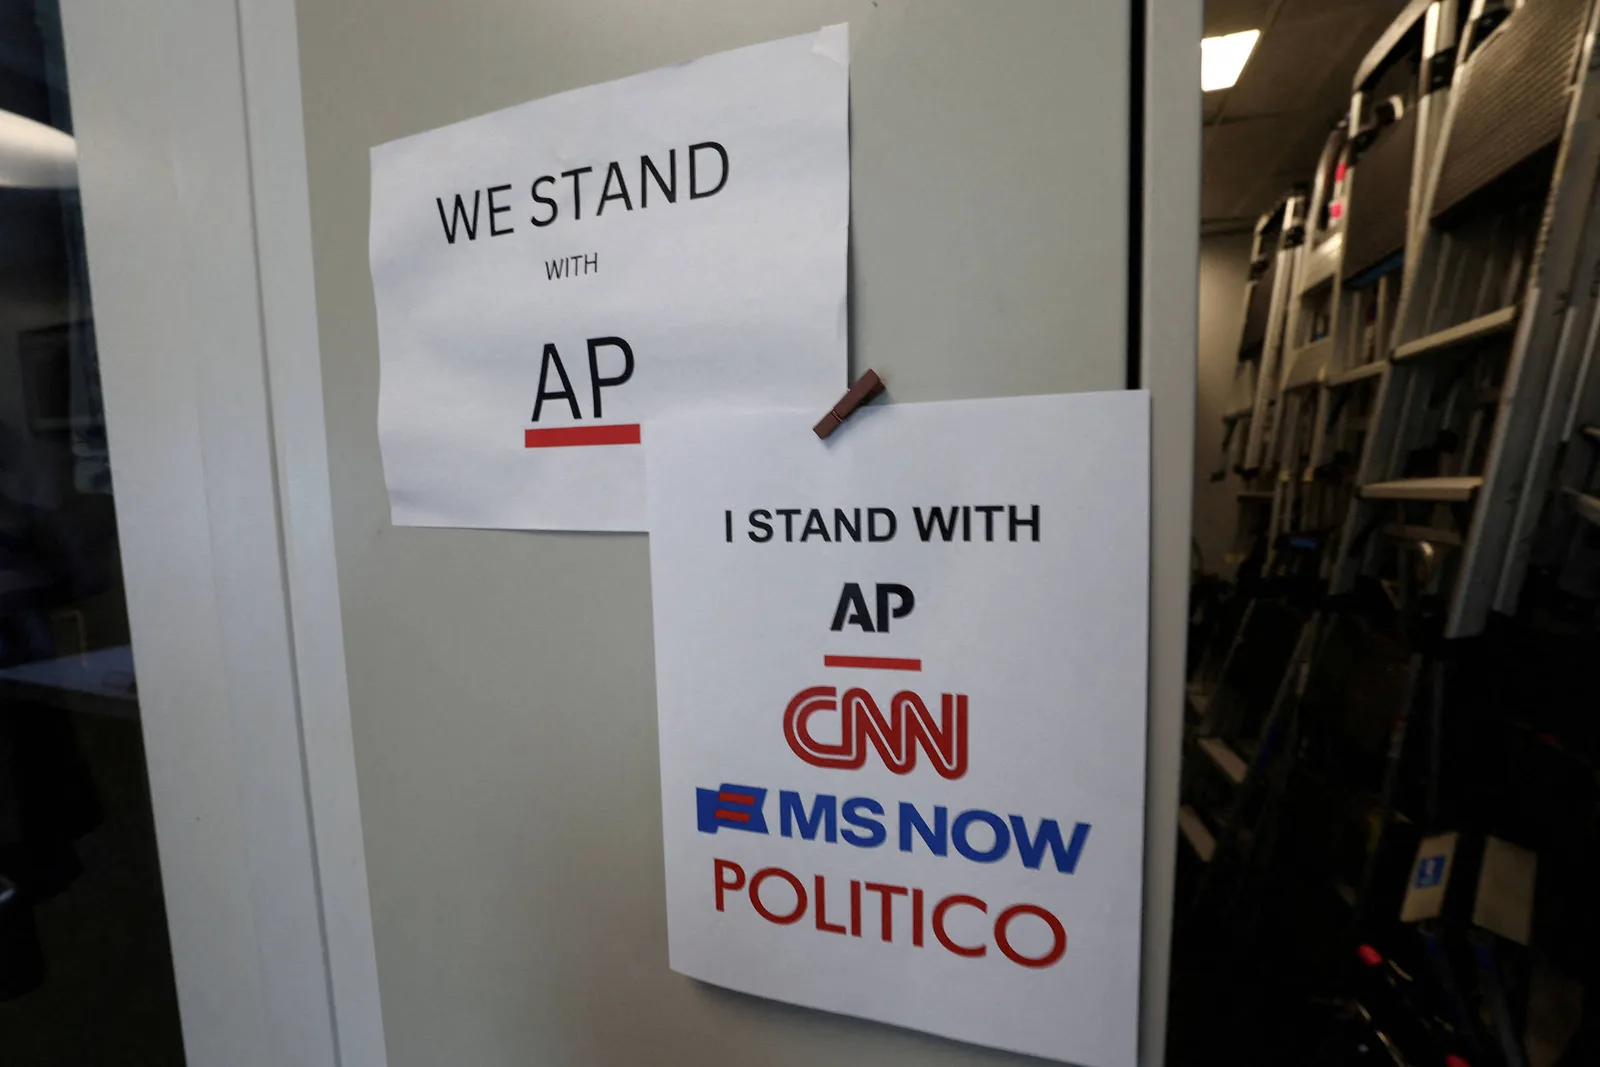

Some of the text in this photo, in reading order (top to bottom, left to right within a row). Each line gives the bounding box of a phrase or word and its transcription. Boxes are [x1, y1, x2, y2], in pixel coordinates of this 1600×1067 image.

[436, 141, 730, 244] WE STAND
[545, 252, 598, 280] WITH
[531, 336, 635, 422] AP
[724, 505, 1041, 543] I STAND WITH
[830, 582, 915, 633] AP
[783, 686, 968, 781] CNN
[779, 790, 1092, 875] MS NOW
[713, 858, 1067, 969] POLITICO
